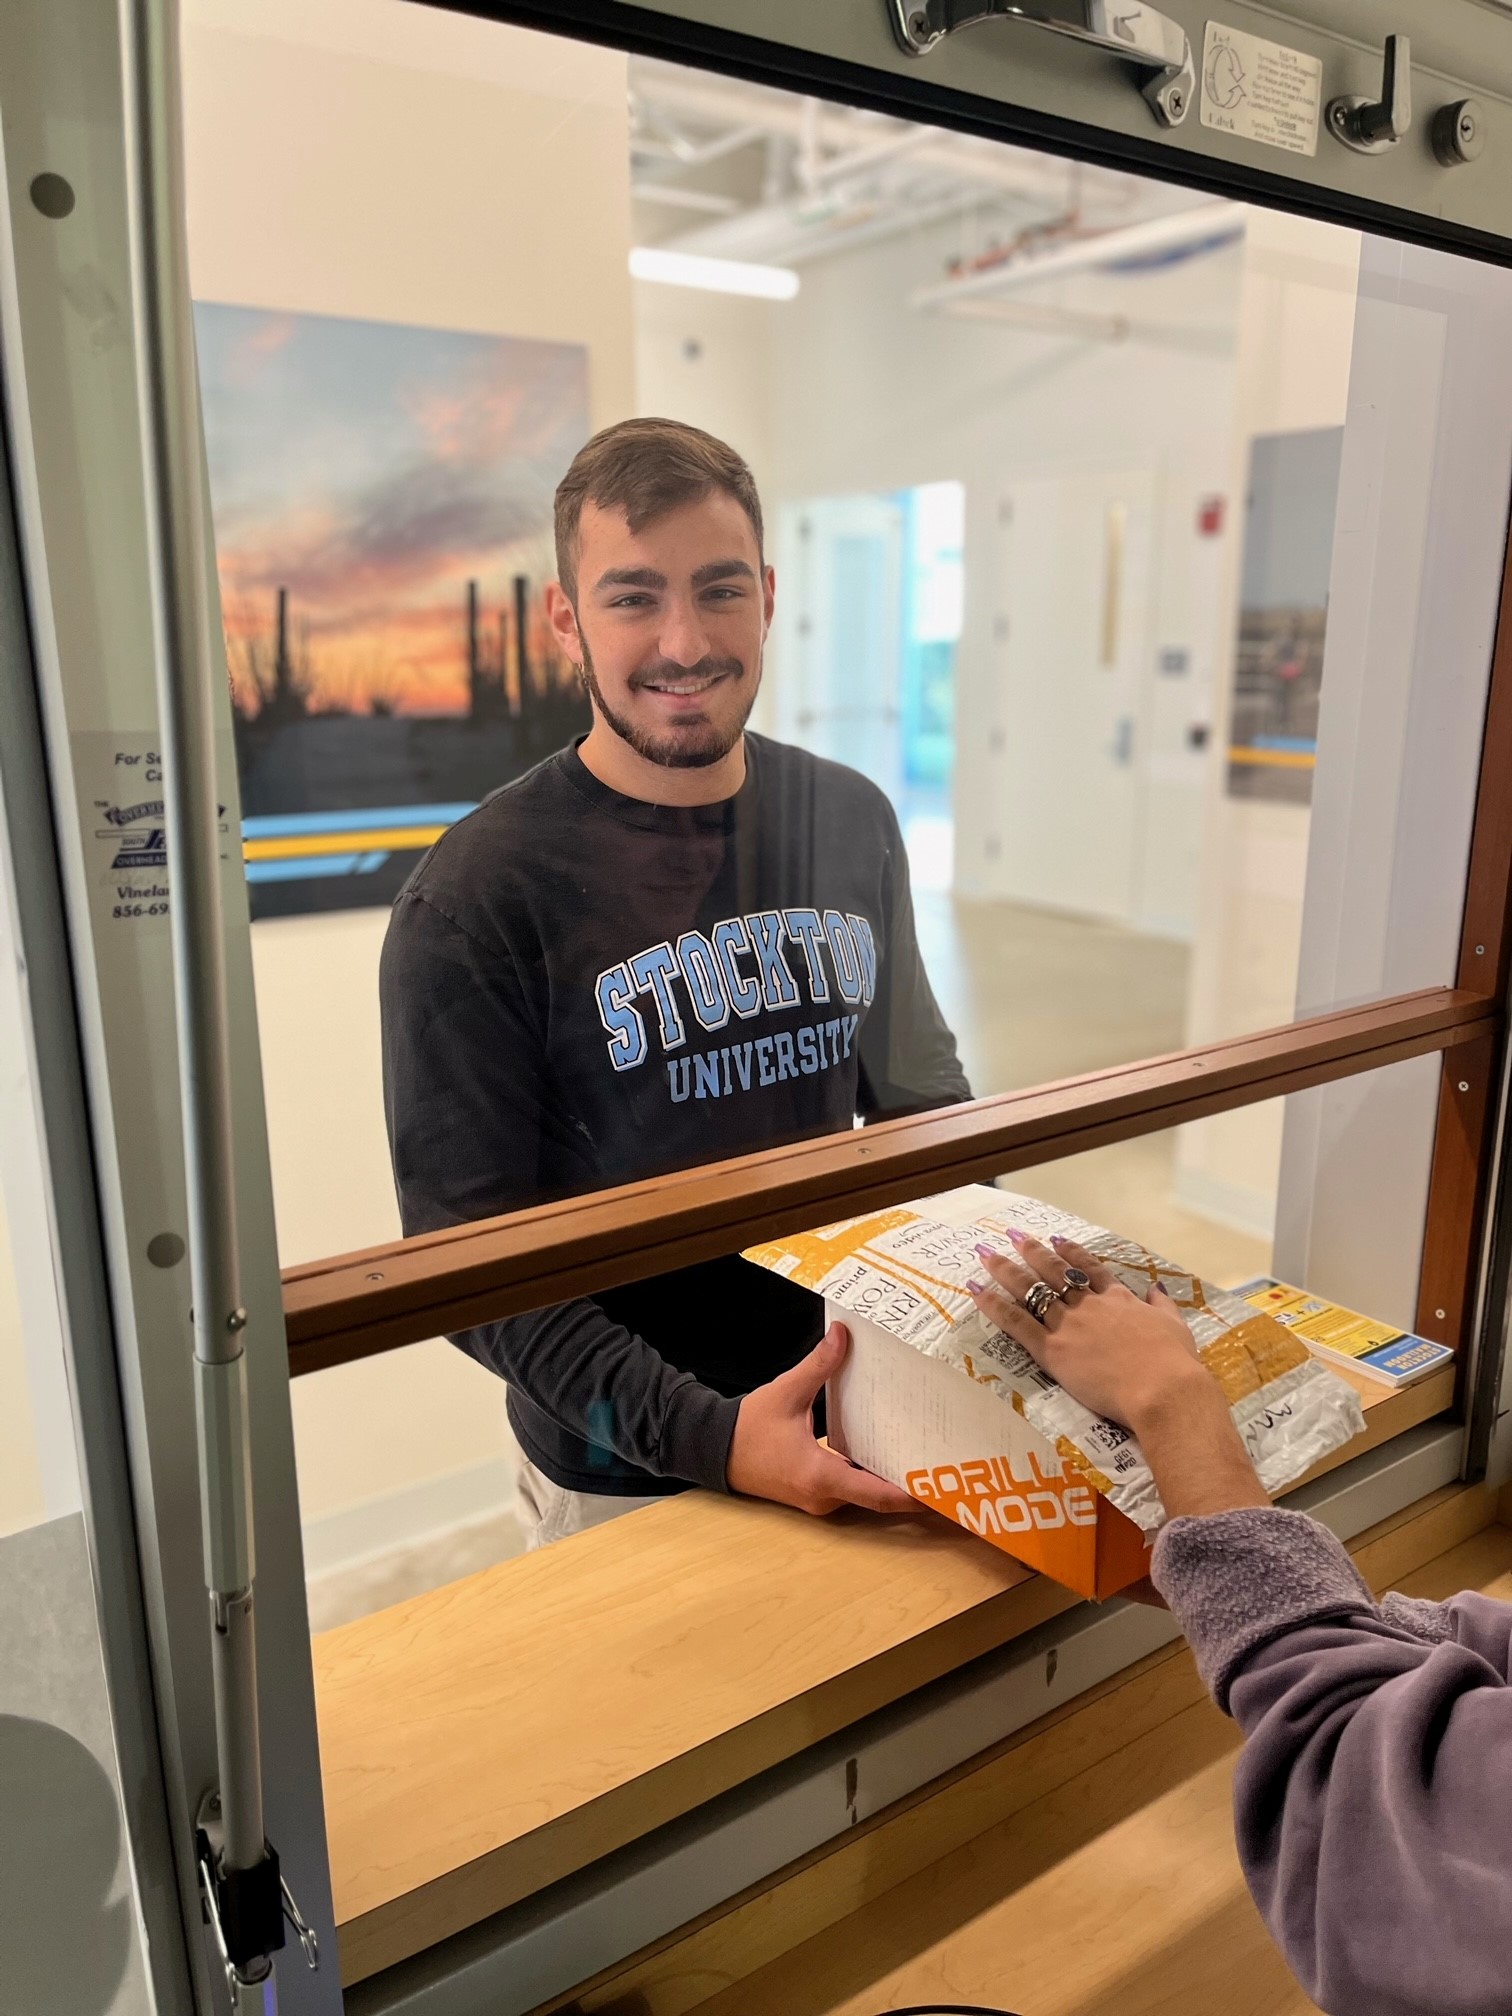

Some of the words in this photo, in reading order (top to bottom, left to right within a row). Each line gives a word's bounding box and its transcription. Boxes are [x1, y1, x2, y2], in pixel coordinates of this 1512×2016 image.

[115, 753, 141, 765] For
[145, 769, 163, 781] Ca
[117, 883, 169, 899] Vinela
[112, 902, 169, 918] 856-69
[594, 908, 877, 1072] STOCKTON
[666, 1013, 859, 1104] UNIVERSITY
[832, 1266, 868, 1300] prime
[853, 1278, 897, 1314] POW
[876, 1291, 921, 1331] RIN
[955, 1486, 1098, 1536] MODE
